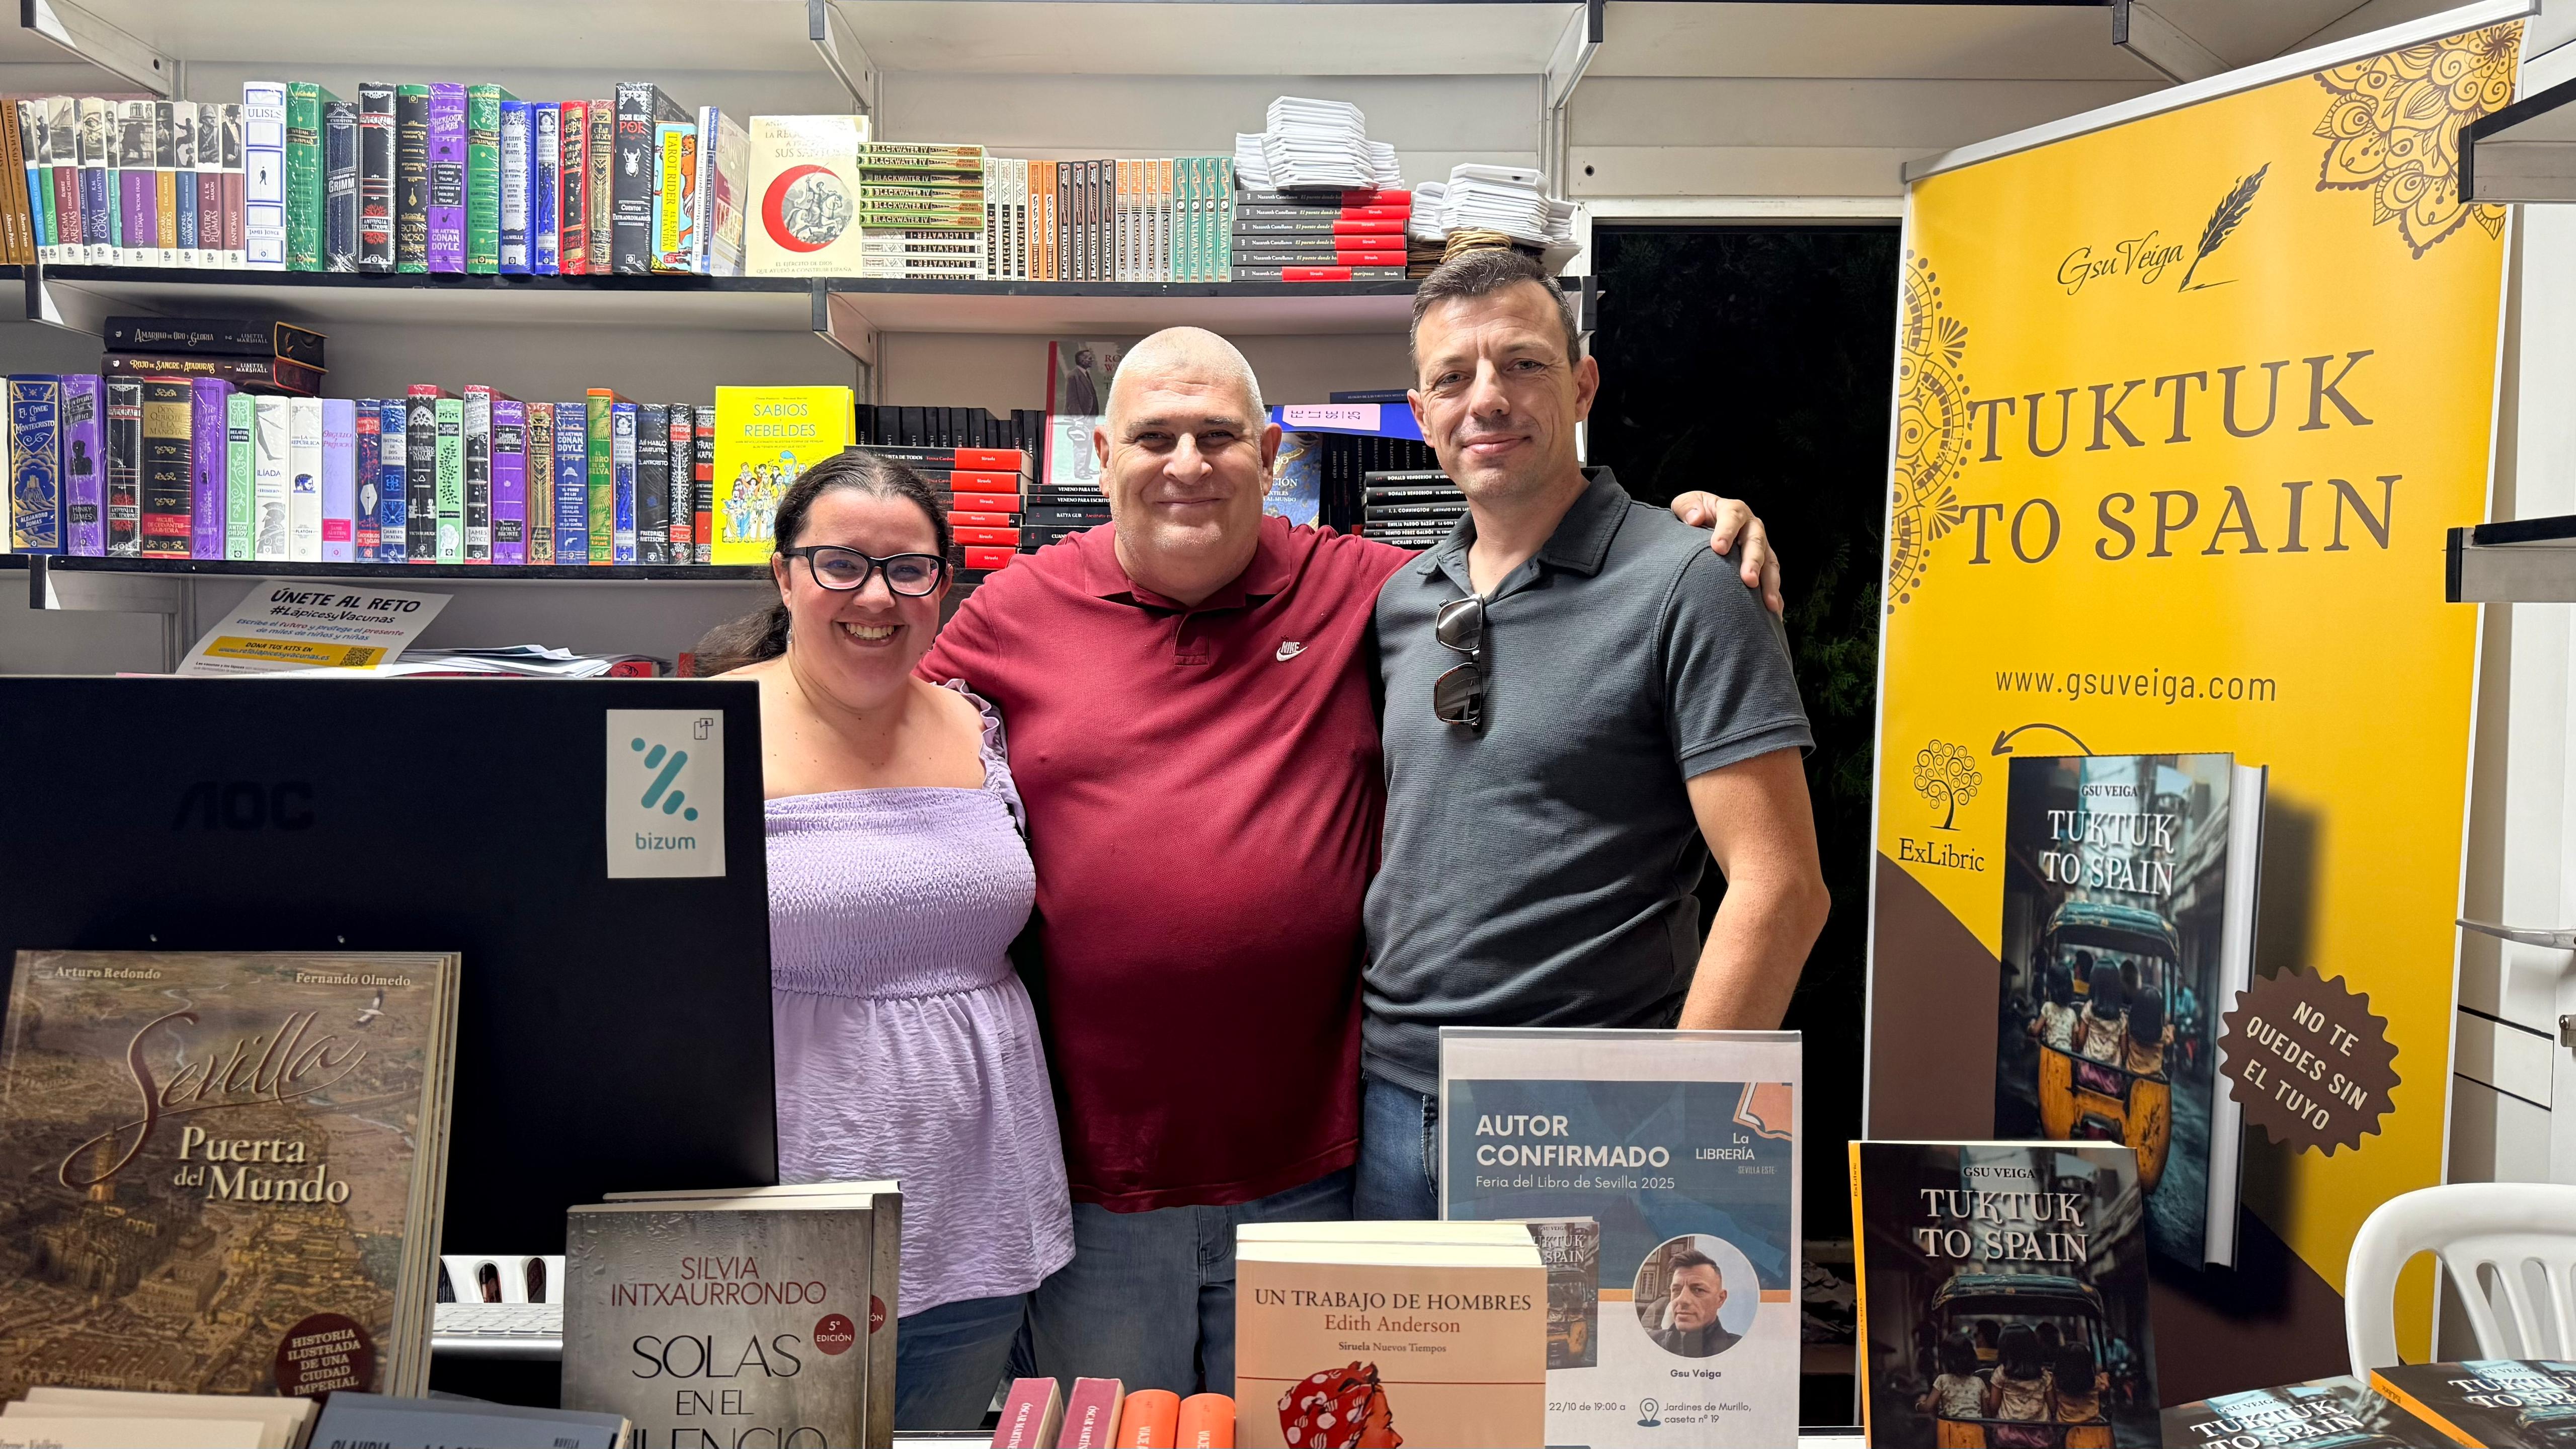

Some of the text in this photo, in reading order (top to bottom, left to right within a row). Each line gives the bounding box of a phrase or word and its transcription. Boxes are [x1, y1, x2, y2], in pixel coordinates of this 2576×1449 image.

[619, 122, 645, 134] POE
[666, 134, 678, 206] TAROT RIDER
[210, 210, 221, 242] PLUMAS
[432, 234, 459, 243] CONAN
[432, 243, 459, 251] DOYLE
[2057, 230, 2185, 295] Gsu Veiga
[134, 329, 166, 343] AMARILLO
[191, 332, 214, 346] GLORIA
[130, 360, 148, 370] ROJO
[156, 361, 180, 370] SANGRE
[184, 361, 215, 374] ATADURAS
[19, 405, 48, 419] EL CONDE
[754, 404, 808, 416] SABIOS
[1291, 410, 1304, 419] FE
[1308, 410, 1321, 419] LI
[1326, 410, 1339, 419] SE
[1966, 349, 2375, 463] TUKTUK
[1347, 411, 1361, 420] 25
[15, 420, 55, 435] MONTECRISTO
[745, 424, 815, 436] REBELDES
[257, 468, 281, 477] ILÍADA
[1960, 474, 2402, 565] TO SPAIN
[271, 587, 421, 613] ÚNETE AL RETO
[270, 606, 396, 624] #LápicesyVacunas
[236, 618, 268, 626] Escribe
[317, 624, 352, 633] protege
[364, 628, 405, 636] presente
[1280, 640, 1301, 654] NIKE
[1996, 667, 2277, 705] www.gsuveiga.com
[2081, 784, 2139, 797] GSU VEIGA
[172, 780, 315, 831] AOC
[2047, 809, 2176, 853] TUKTUK
[635, 832, 696, 850] bizum
[1898, 836, 1985, 872] ExLibric
[2042, 851, 2176, 897] TO SPAIN
[55, 965, 161, 980] Arturo Redondo
[295, 972, 412, 987] Fernando Olmedo
[2292, 1001, 2359, 1057] NO TE
[2246, 1016, 2368, 1110] QUEDES SIN
[2243, 1059, 2330, 1130] EL TUYO
[1475, 1114, 1569, 1137] AUTOR
[178, 1126, 307, 1164] Puerta
[1733, 1132, 1749, 1145] La
[1476, 1144, 1670, 1168] CONFIRMADO
[1695, 1145, 1755, 1161] LIBRERÍA
[1963, 1166, 2036, 1179] GSU VEIGA
[174, 1164, 352, 1204] del Mundo
[1476, 1175, 1675, 1189] Feria del Libro de Sevilla 2025
[1920, 1188, 2085, 1227] TUKTUK
[1533, 1234, 1585, 1249] UKTUK
[1918, 1229, 2089, 1263] TO SPAIN
[1545, 1250, 1585, 1263] SPAIN
[681, 1256, 759, 1280] SILVIA
[611, 1280, 827, 1307] INTXAURRONDO
[1255, 1289, 1532, 1312] UN TRABAJO DE HOMBRES
[1325, 1314, 1460, 1333] Edith Anderson
[292, 1328, 356, 1348] HISTORIA
[816, 1332, 852, 1342] EDICIÓN
[288, 1339, 361, 1361] ILUSTRADA
[631, 1333, 801, 1379] SOLAS
[1338, 1341, 1446, 1353] Siruela Nuevos Tiempos
[300, 1353, 350, 1371] DE UNA
[300, 1365, 351, 1382] CIUDAD
[1670, 1369, 1722, 1380] Gsu Veiga
[294, 1376, 360, 1396] IMPERIAL
[2447, 1375, 2576, 1393] TUKTU
[676, 1389, 755, 1416] EN EL
[1549, 1401, 1577, 1412] 22/10
[1579, 1401, 1591, 1411] de
[1593, 1402, 1618, 1411] 19:00
[1664, 1402, 1752, 1413] Jardines de Murillo,
[2217, 1397, 2281, 1415] GSU VEIGA
[2468, 1393, 2523, 1409] TO
[1017, 1402, 1033, 1422] ÓSCAR
[1664, 1415, 1696, 1424] caseta
[1711, 1414, 1719, 1423] 19
[2190, 1400, 2345, 1439] TUKTUK
[1137, 1426, 1151, 1444] VIAJE
[2205, 1414, 2365, 1449] TO SPAIN
